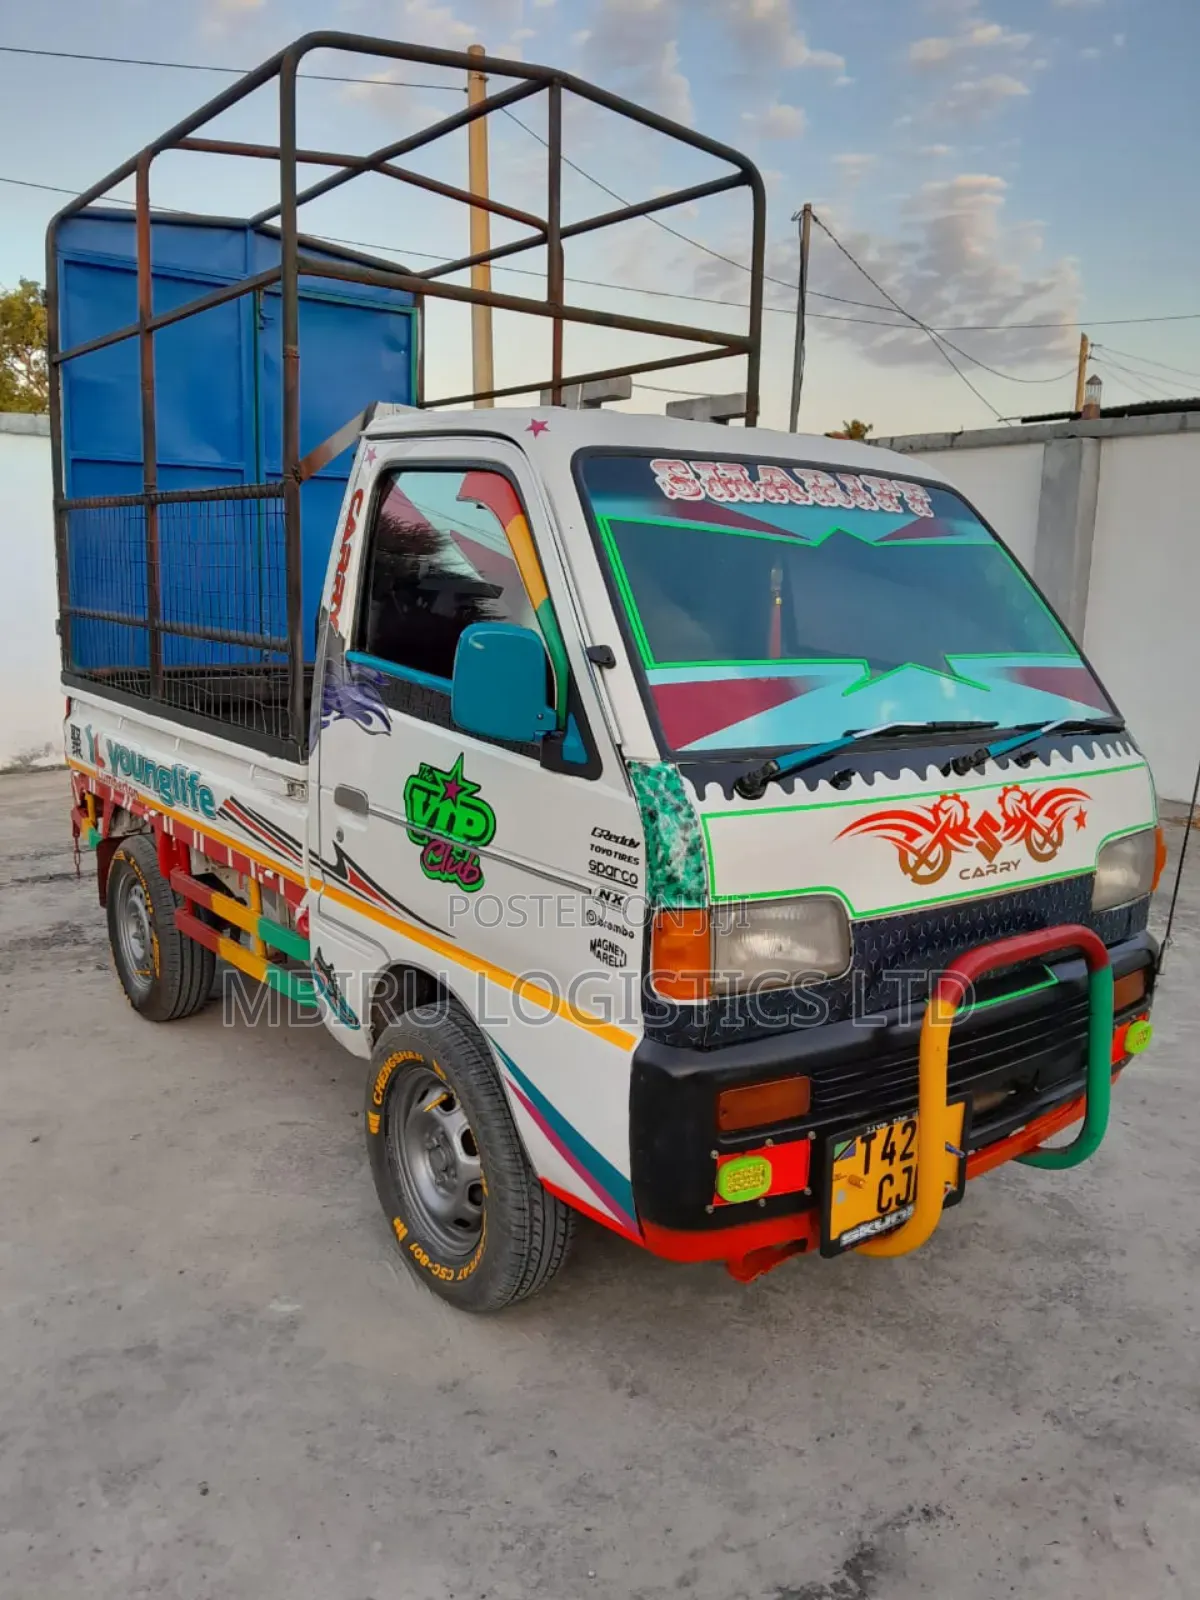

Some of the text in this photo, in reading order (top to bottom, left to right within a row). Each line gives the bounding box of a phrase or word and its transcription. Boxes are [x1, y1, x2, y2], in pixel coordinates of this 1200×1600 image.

[650, 459, 934, 518] SHARIFF
[330, 488, 364, 632] CARRY
[107, 739, 217, 821] younglife
[411, 786, 489, 844] VIP
[422, 839, 482, 884] Club
[588, 859, 639, 887] sparco
[589, 843, 640, 866] TOYO TIRES
[958, 859, 1022, 881] CARRY
[860, 1119, 918, 1176] T 42
[876, 1164, 919, 1214] CJ
[409, 1243, 455, 1281] CSC-801
